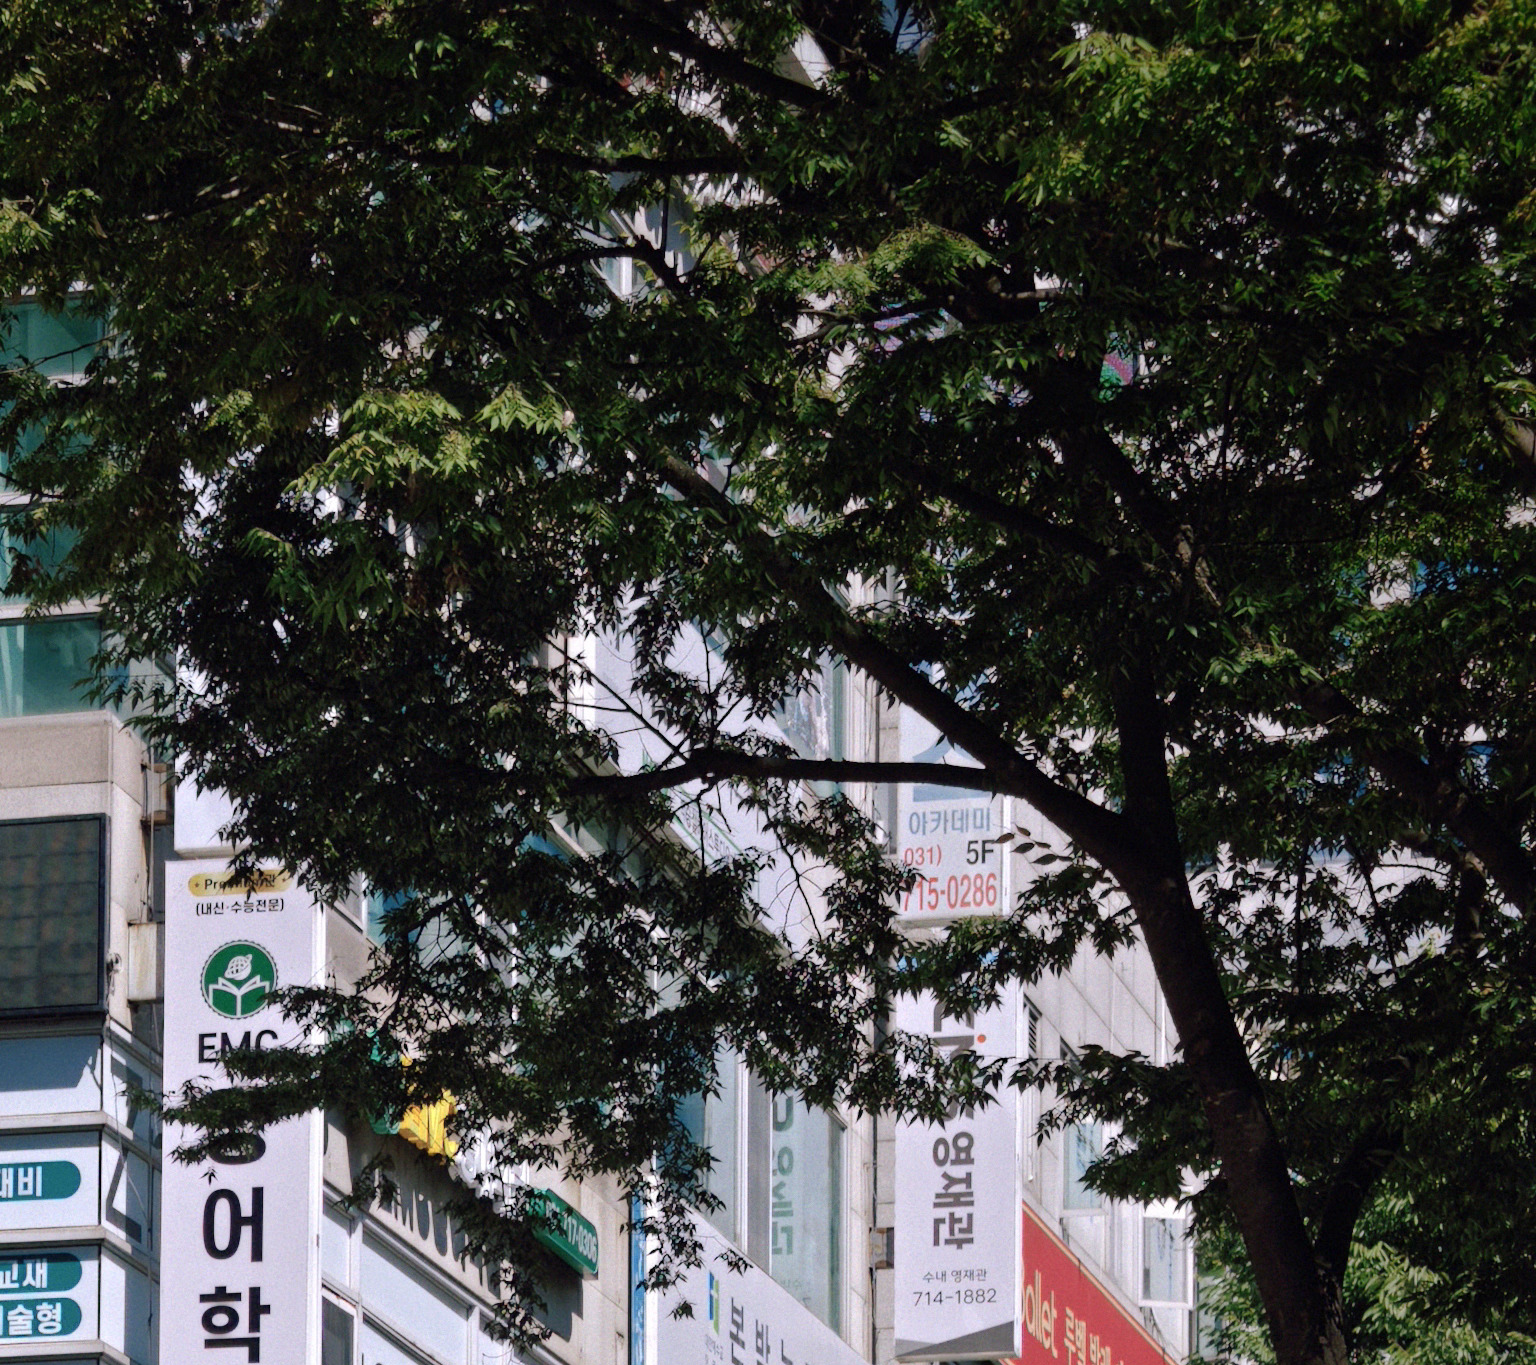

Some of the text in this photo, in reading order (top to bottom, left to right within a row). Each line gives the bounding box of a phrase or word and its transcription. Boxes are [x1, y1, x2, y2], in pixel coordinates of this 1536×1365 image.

[907, 809, 992, 837] 아카데미
[965, 840, 995, 865] 5F
[901, 872, 998, 912] 715-0286
[922, 1267, 988, 1285] 수내 영재관
[912, 1287, 998, 1307] 714-1882
